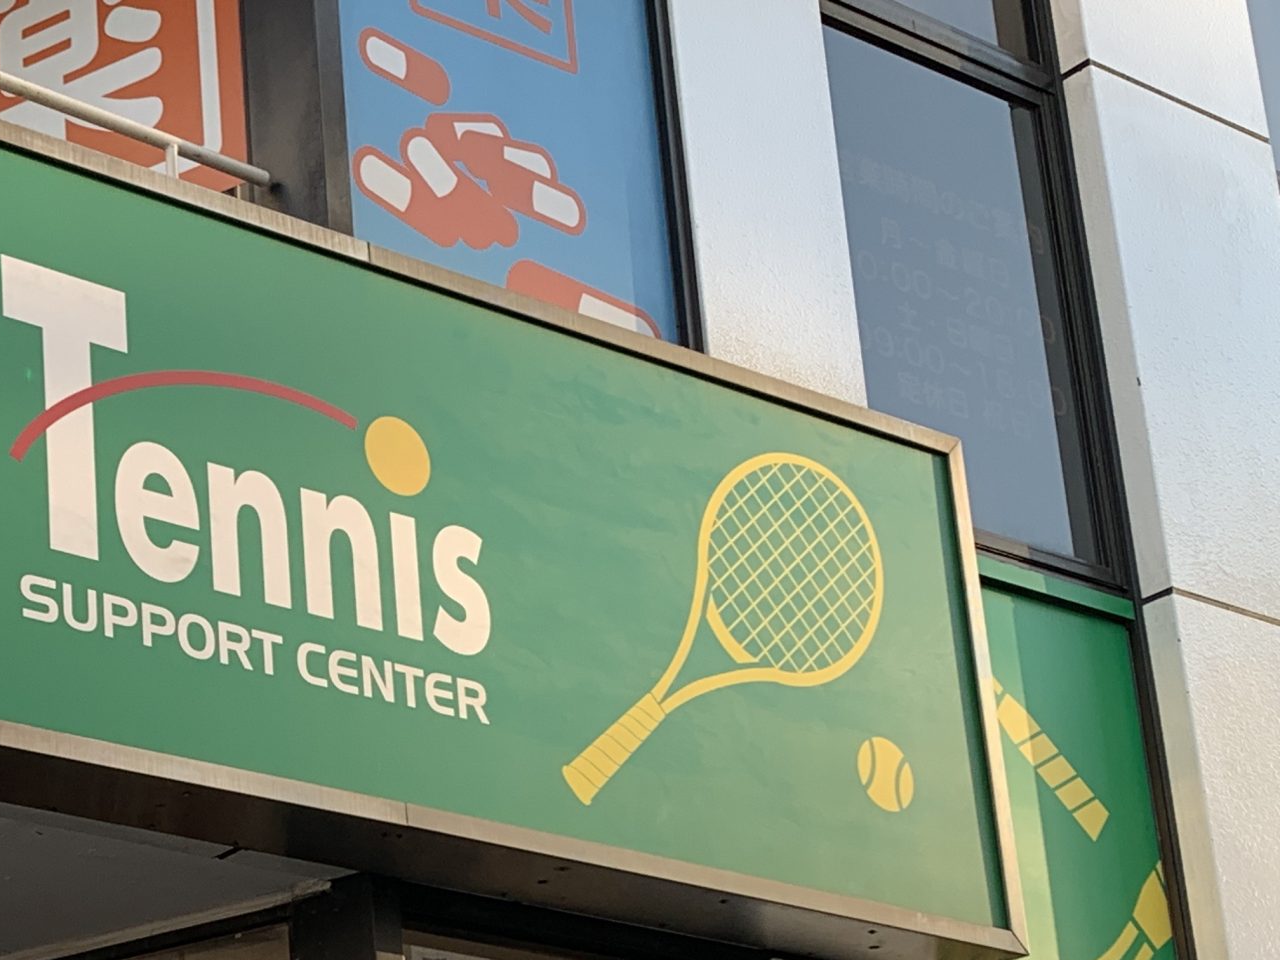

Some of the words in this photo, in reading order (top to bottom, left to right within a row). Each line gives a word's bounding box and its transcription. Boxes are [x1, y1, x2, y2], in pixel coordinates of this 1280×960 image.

[0, 253, 491, 656] Tennis
[20, 574, 283, 676] SUPPORT
[296, 643, 490, 725] CENTER
